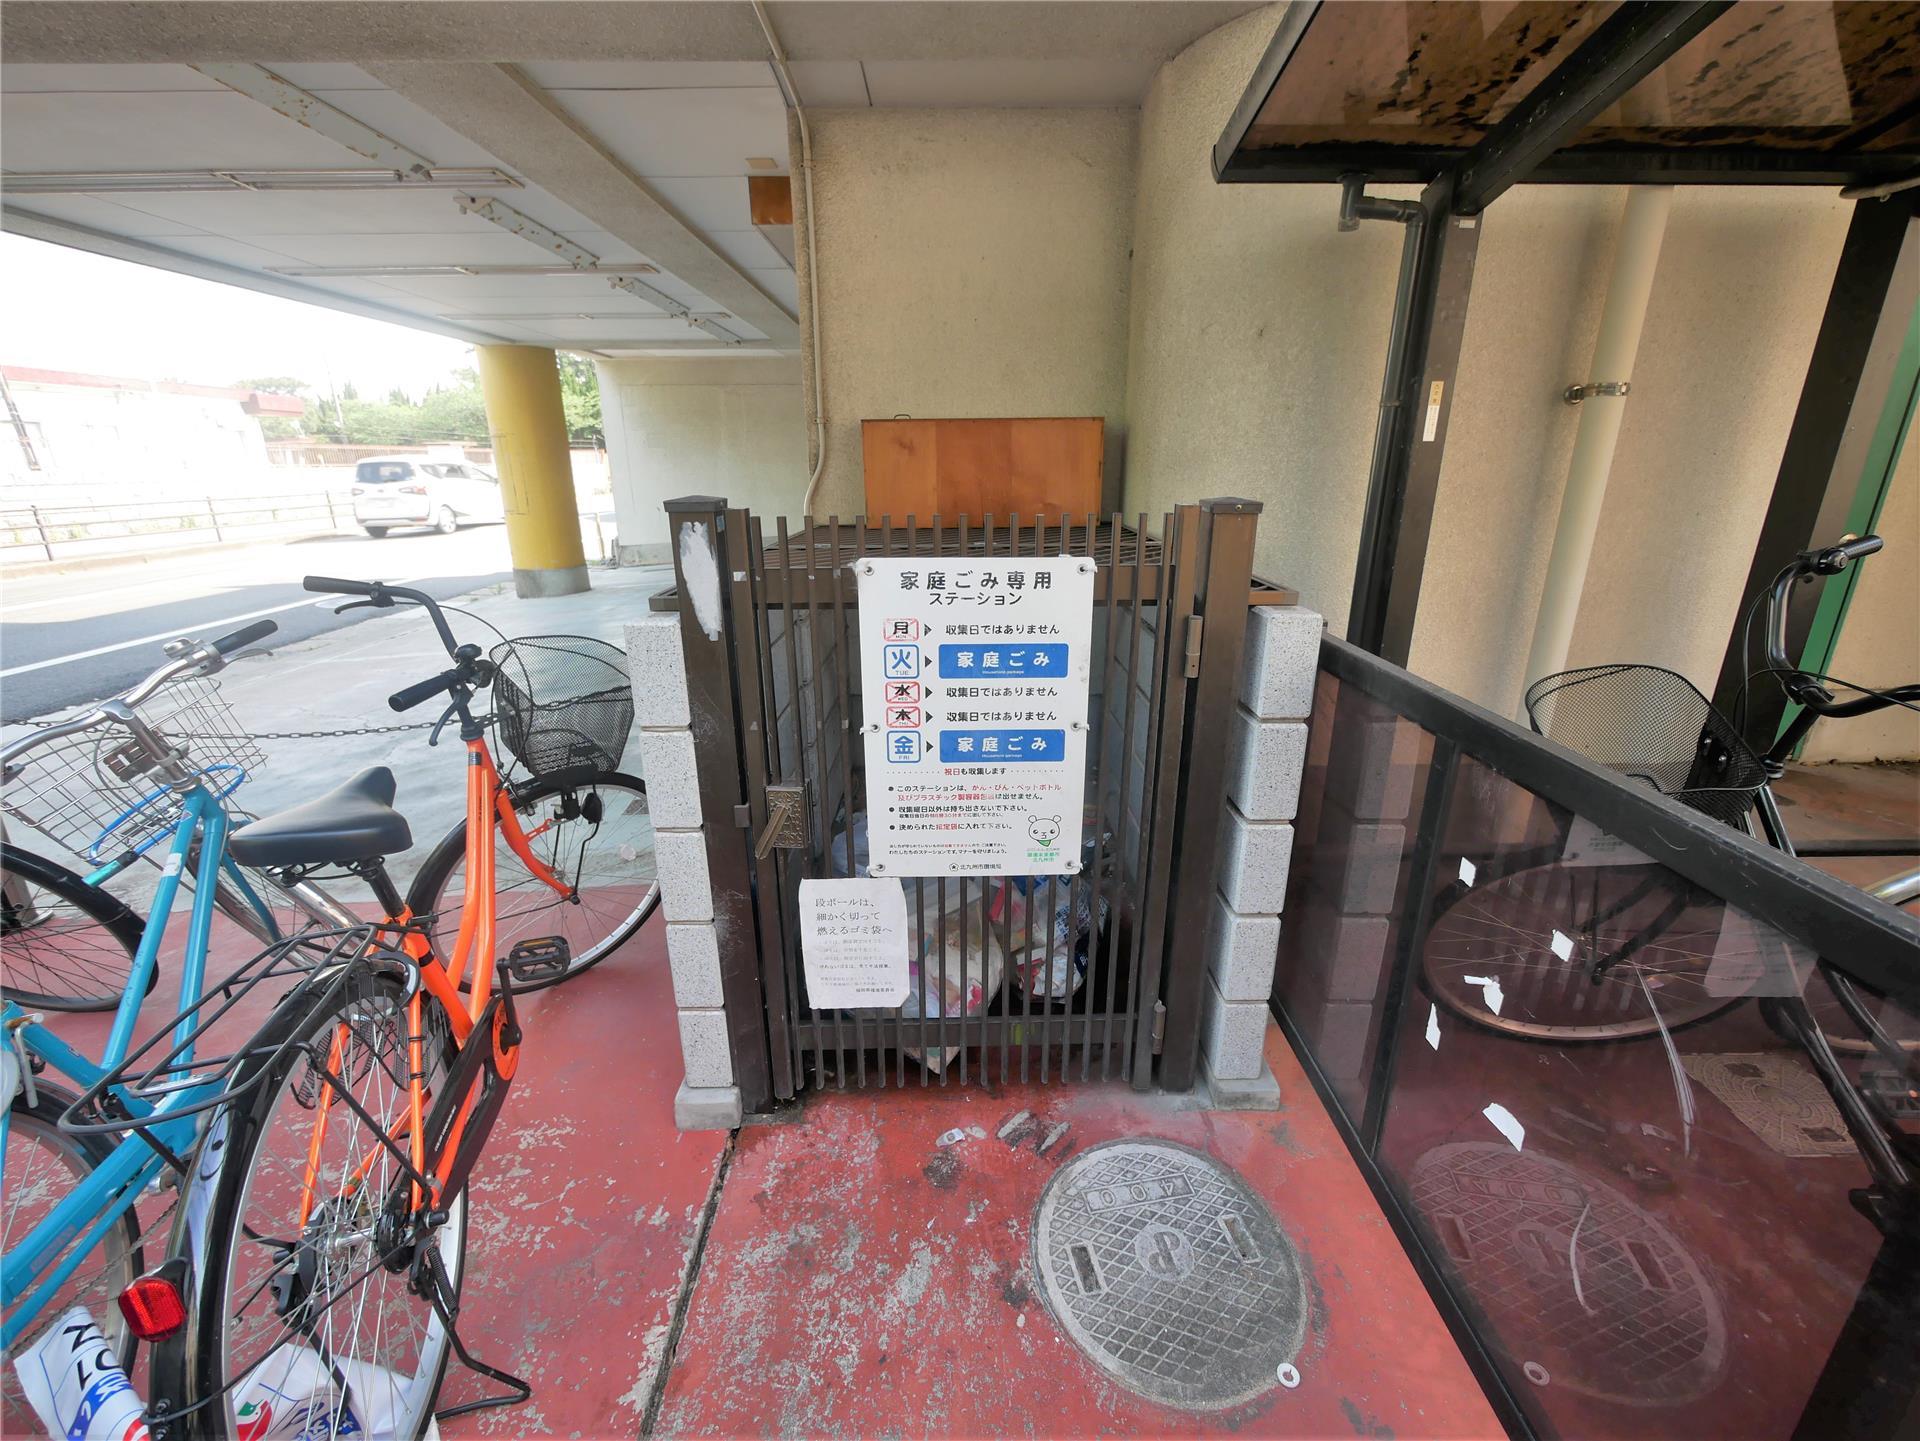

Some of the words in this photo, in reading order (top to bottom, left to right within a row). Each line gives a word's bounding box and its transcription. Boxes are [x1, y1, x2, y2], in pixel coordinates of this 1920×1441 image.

[900, 570, 1051, 590] 家庭ごみ専用
[929, 592, 1022, 606] ステーション
[893, 622, 909, 635] 月
[945, 624, 1060, 636] 収集日ではありません
[892, 649, 911, 670] 火
[957, 651, 1050, 668] 家庭ごみ
[894, 684, 911, 697] 水
[946, 687, 1058, 698] 収集日ではありません
[895, 709, 911, 721] 木
[946, 711, 1057, 722] 収集日ではありません
[894, 735, 914, 755] 金
[957, 736, 1047, 753] 家庭ごみ
[944, 767, 1007, 776] 祝日も収集します
[815, 898, 876, 909] 段ボールは、
[816, 911, 881, 922] 細かく切って
[817, 926, 893, 936] 燃えるゴミ袋へ
